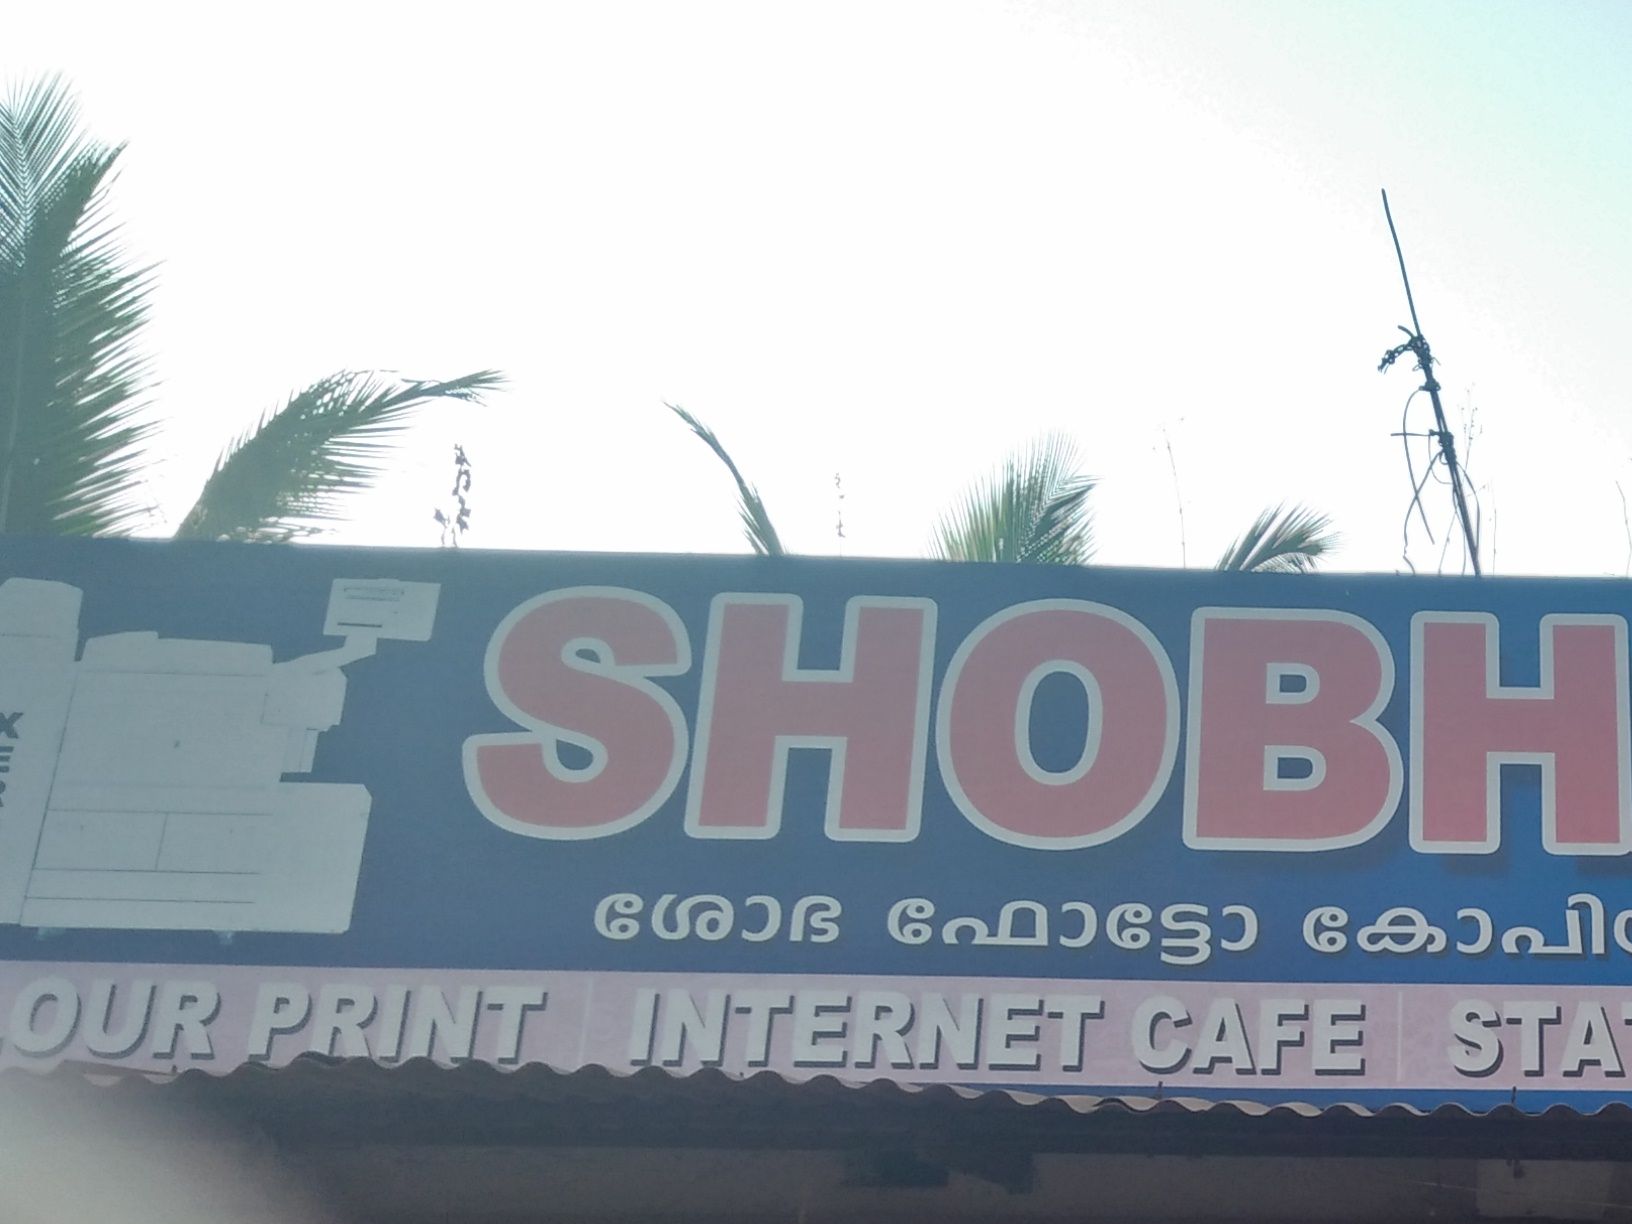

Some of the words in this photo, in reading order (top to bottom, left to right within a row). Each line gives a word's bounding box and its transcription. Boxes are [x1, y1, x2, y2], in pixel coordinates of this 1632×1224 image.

[592, 892, 844, 944] ശോഭ
[886, 897, 1261, 966] ഫോട്ടോ
[248, 979, 548, 1066] PRINT
[628, 987, 1106, 1076] INTERNET
[1130, 995, 1367, 1077] CAFE
